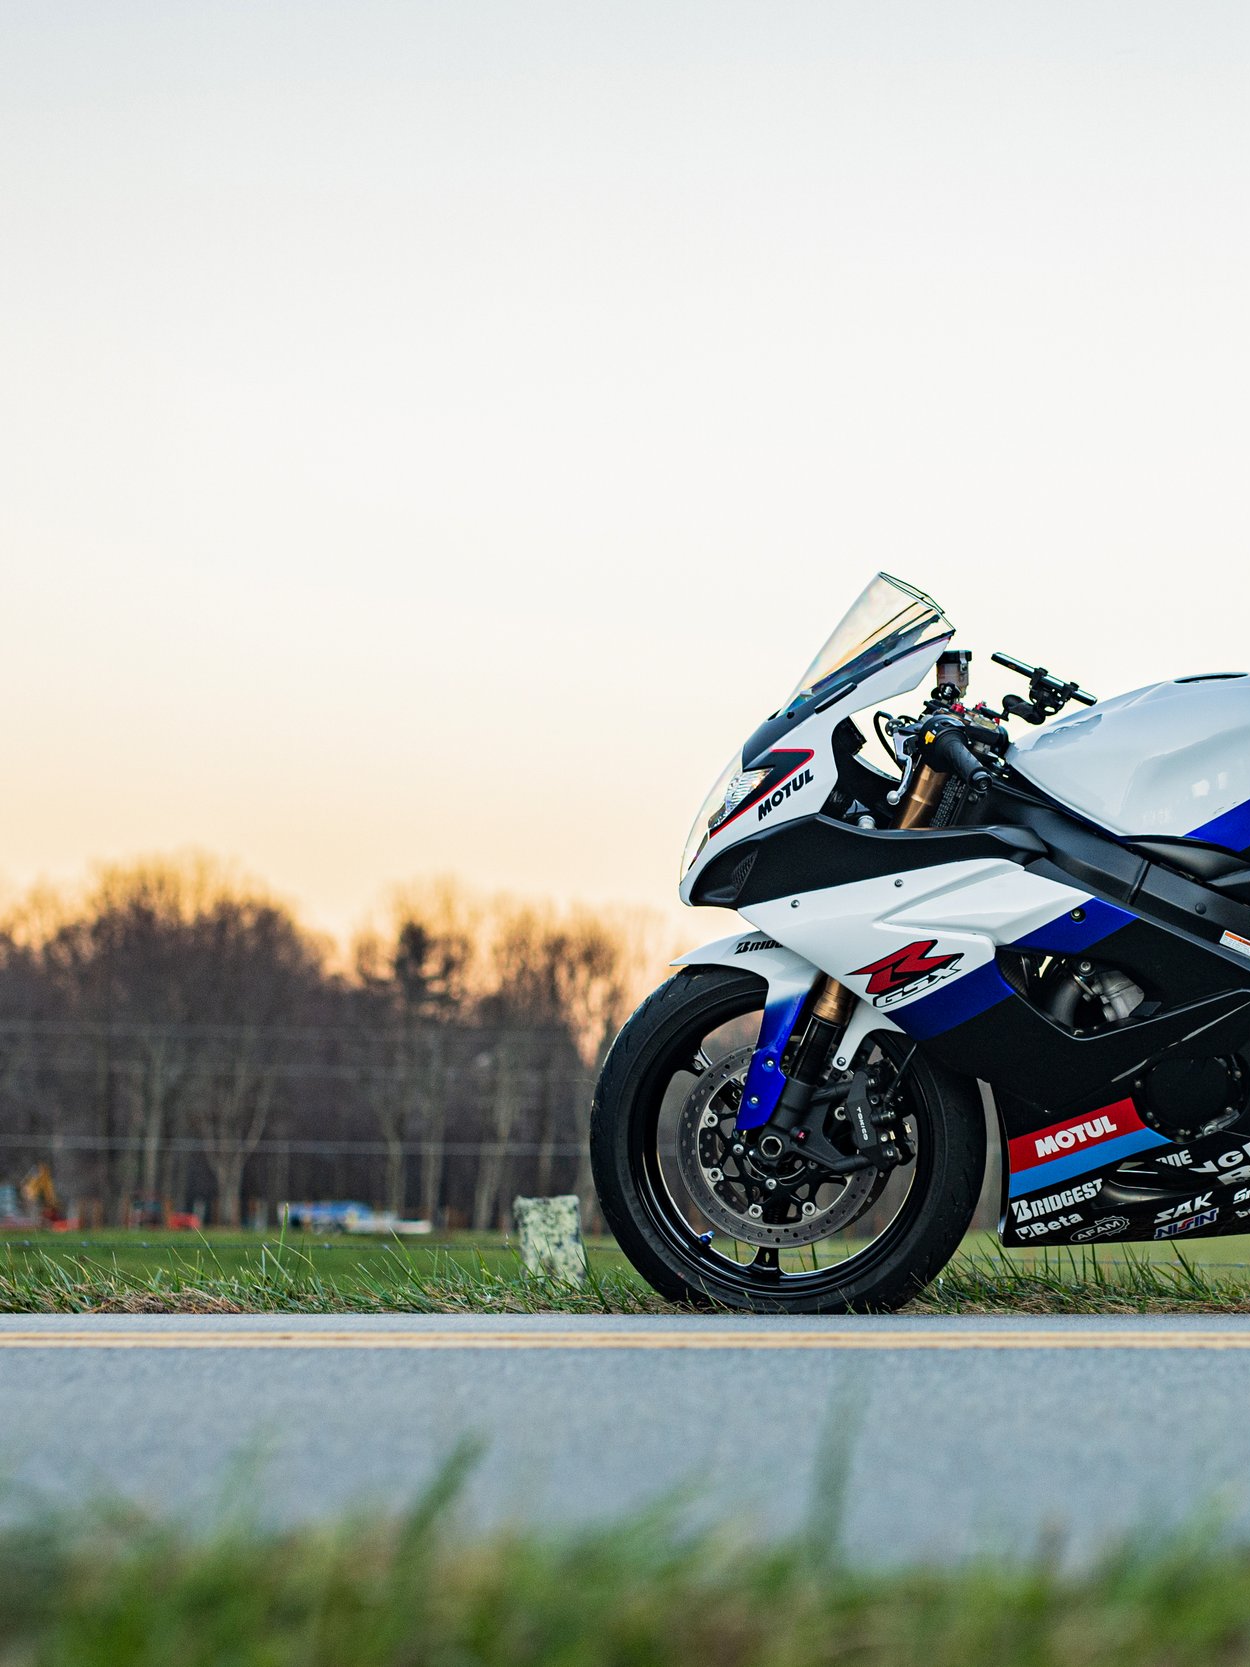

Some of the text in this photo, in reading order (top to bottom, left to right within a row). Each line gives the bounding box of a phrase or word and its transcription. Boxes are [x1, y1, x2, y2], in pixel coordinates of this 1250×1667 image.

[758, 769, 814, 821] MOTUL
[856, 1106, 869, 1141] TOKICO
[1034, 1115, 1118, 1158] MOTUL
[1011, 1178, 1103, 1223] BRIDGEST
[1030, 1212, 1084, 1237] Beta
[1077, 1220, 1121, 1240] AFAM
